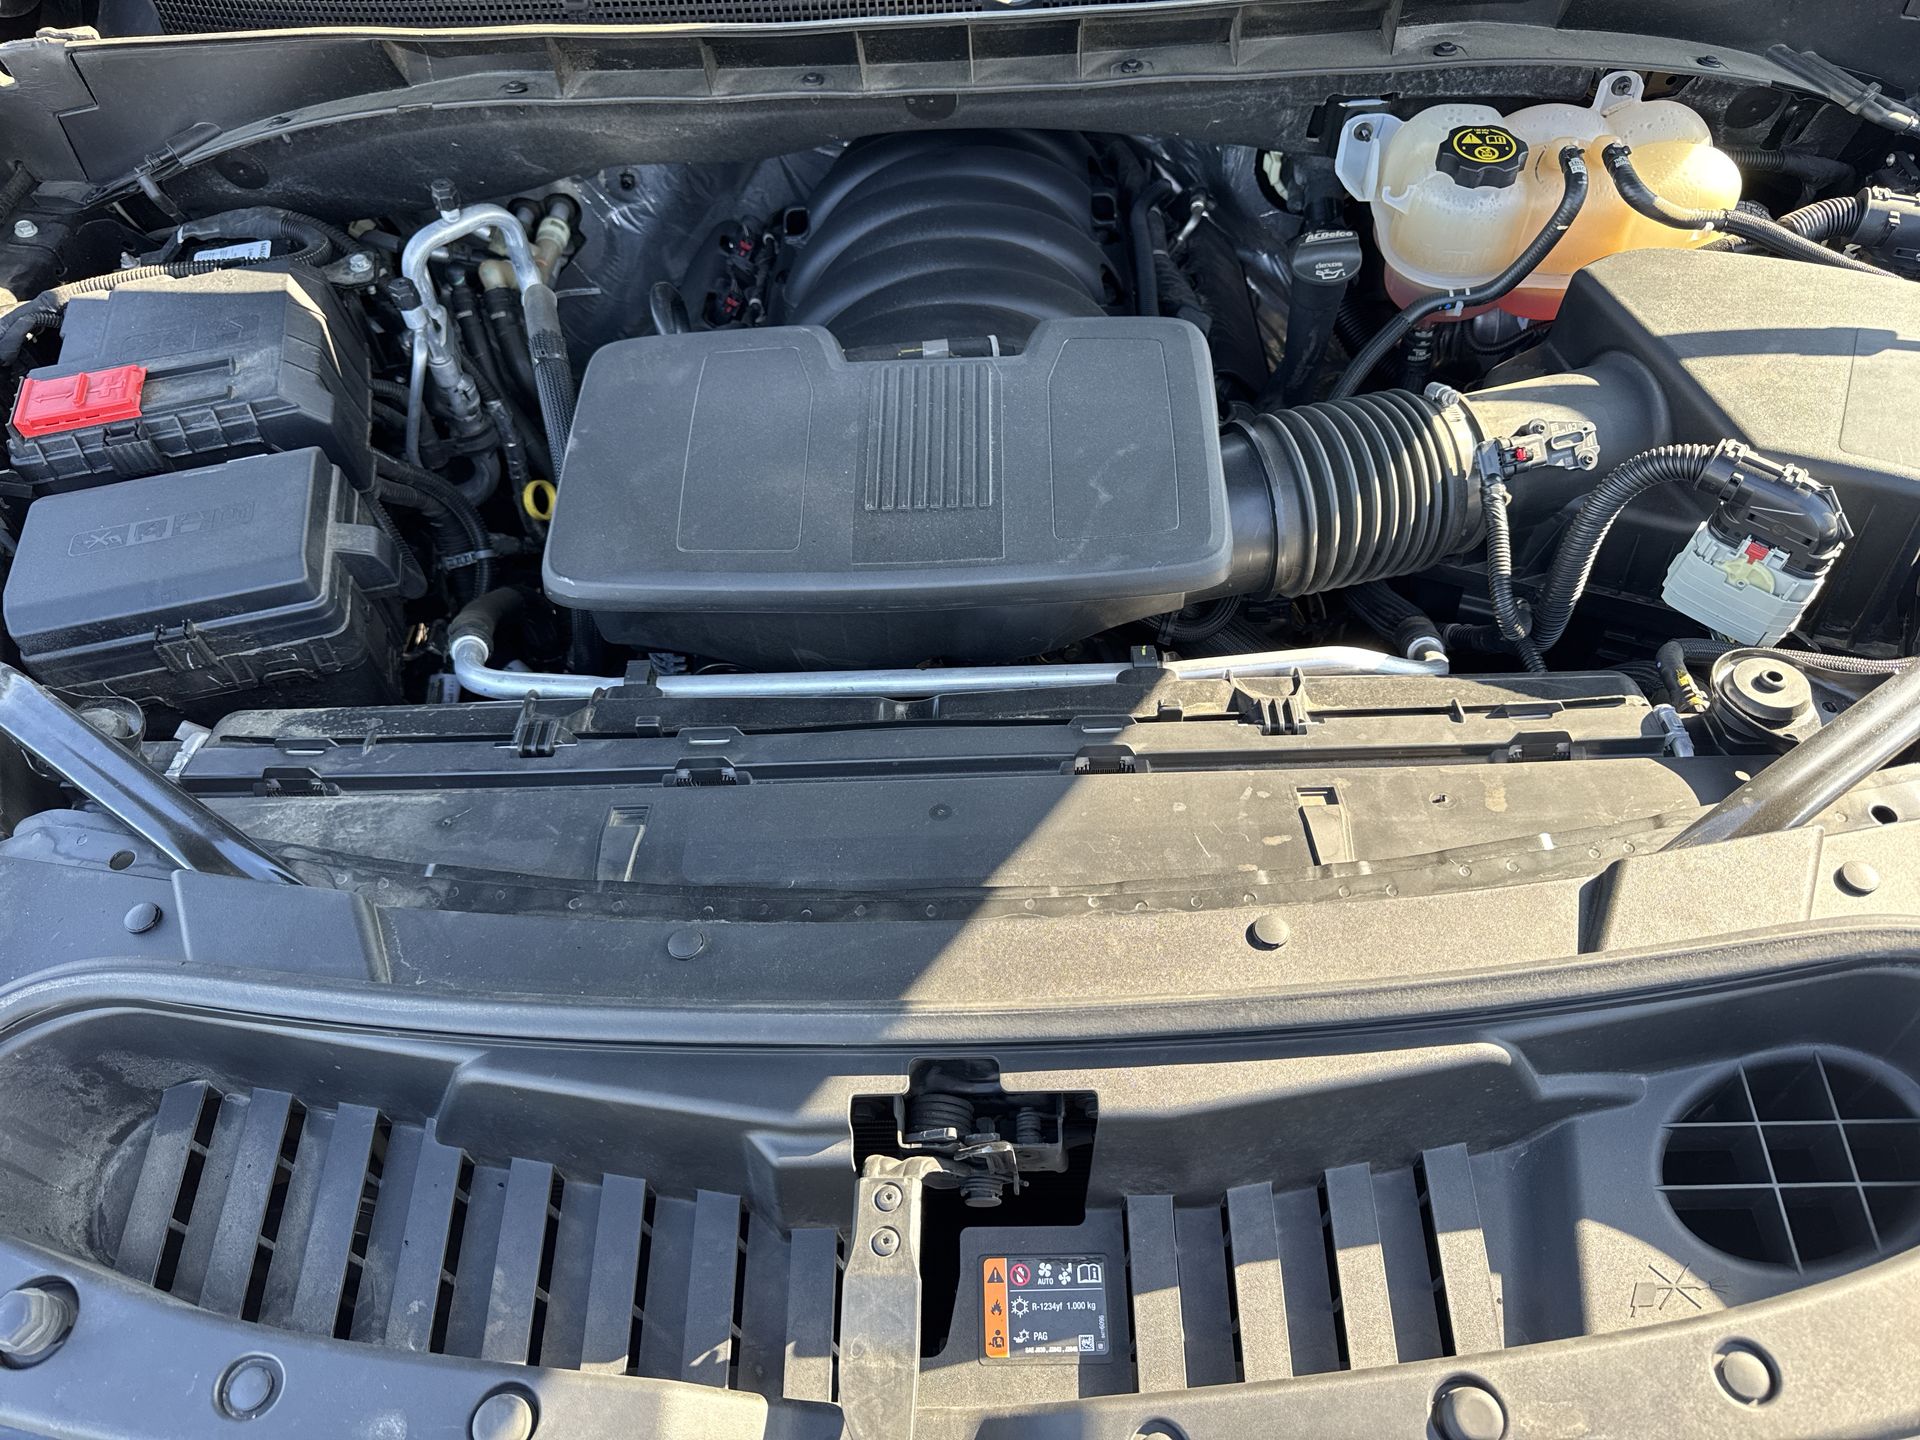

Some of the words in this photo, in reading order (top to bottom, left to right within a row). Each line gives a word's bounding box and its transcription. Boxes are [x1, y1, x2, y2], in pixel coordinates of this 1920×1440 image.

[1305, 230, 1353, 243] ACDelco
[1037, 1277, 1054, 1285] AUTO
[1031, 1302, 1063, 1312] R-1234yf
[1066, 1302, 1086, 1310] 1.000
[1087, 1301, 1096, 1311] kg
[1033, 1331, 1048, 1340] PAG
